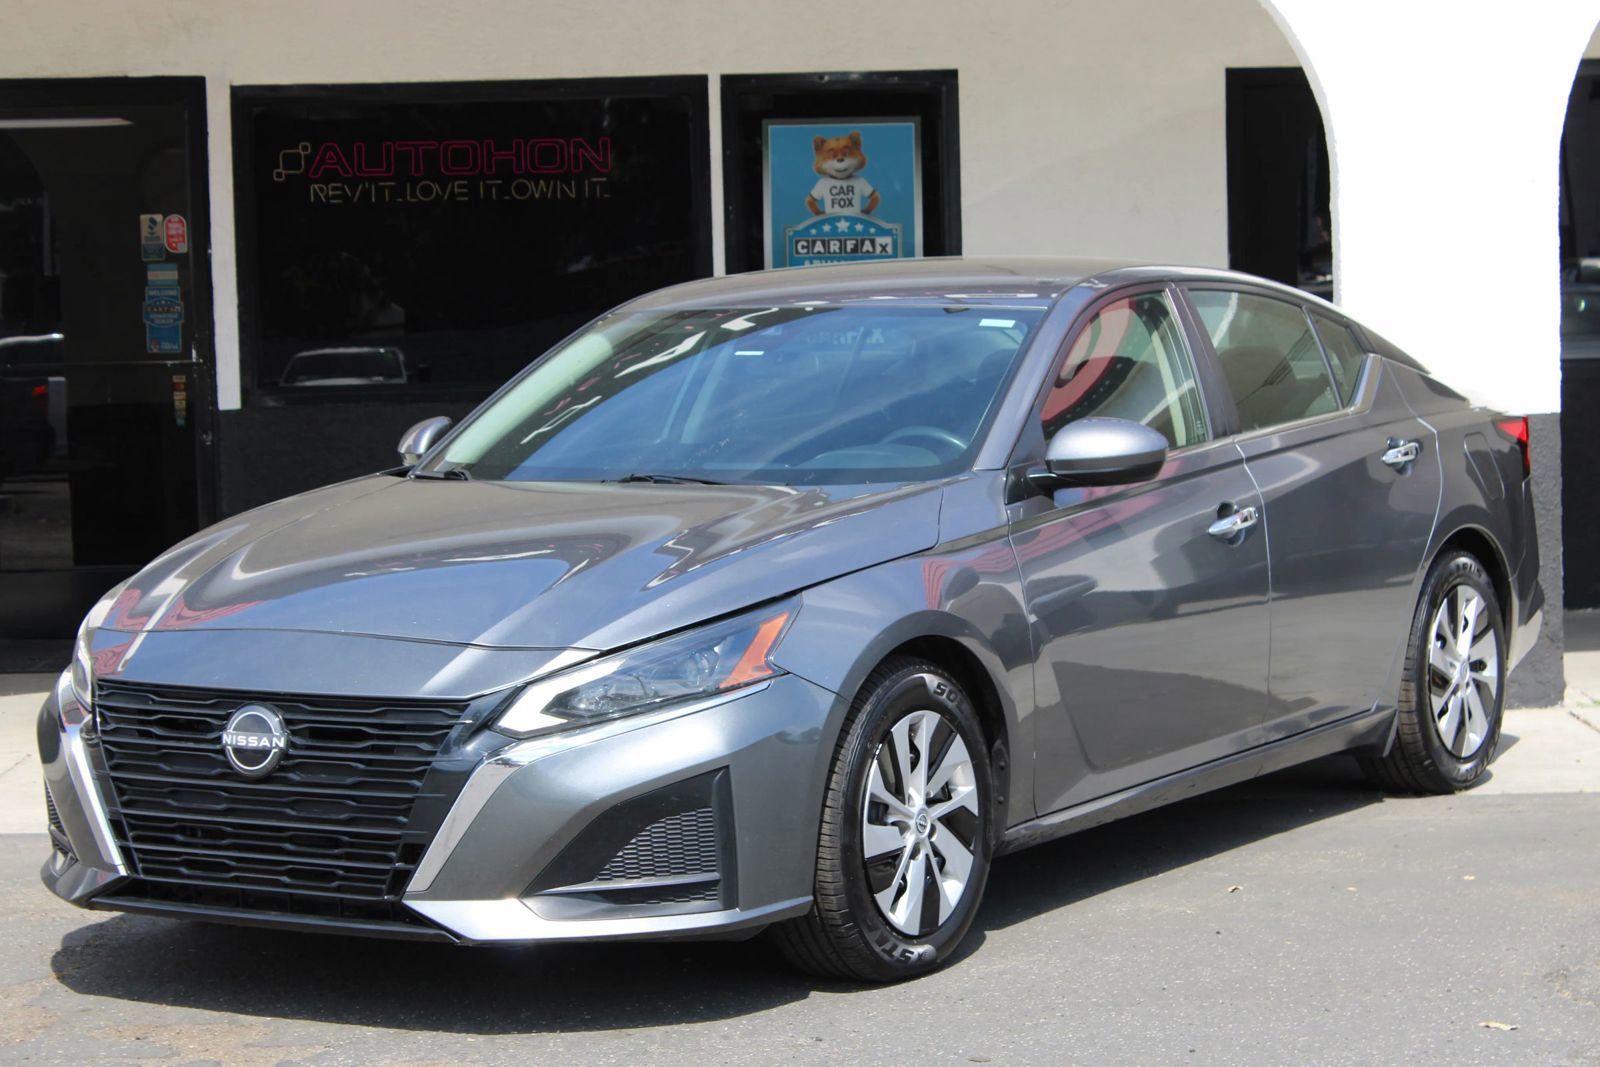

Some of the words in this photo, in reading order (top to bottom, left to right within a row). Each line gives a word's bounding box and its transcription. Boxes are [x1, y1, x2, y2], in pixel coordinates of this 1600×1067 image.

[308, 137, 612, 178] AUTOHON
[829, 184, 856, 197] CAR
[830, 197, 855, 209] FOX
[796, 239, 890, 255] CARFAX
[222, 733, 285, 748] NISSAN
